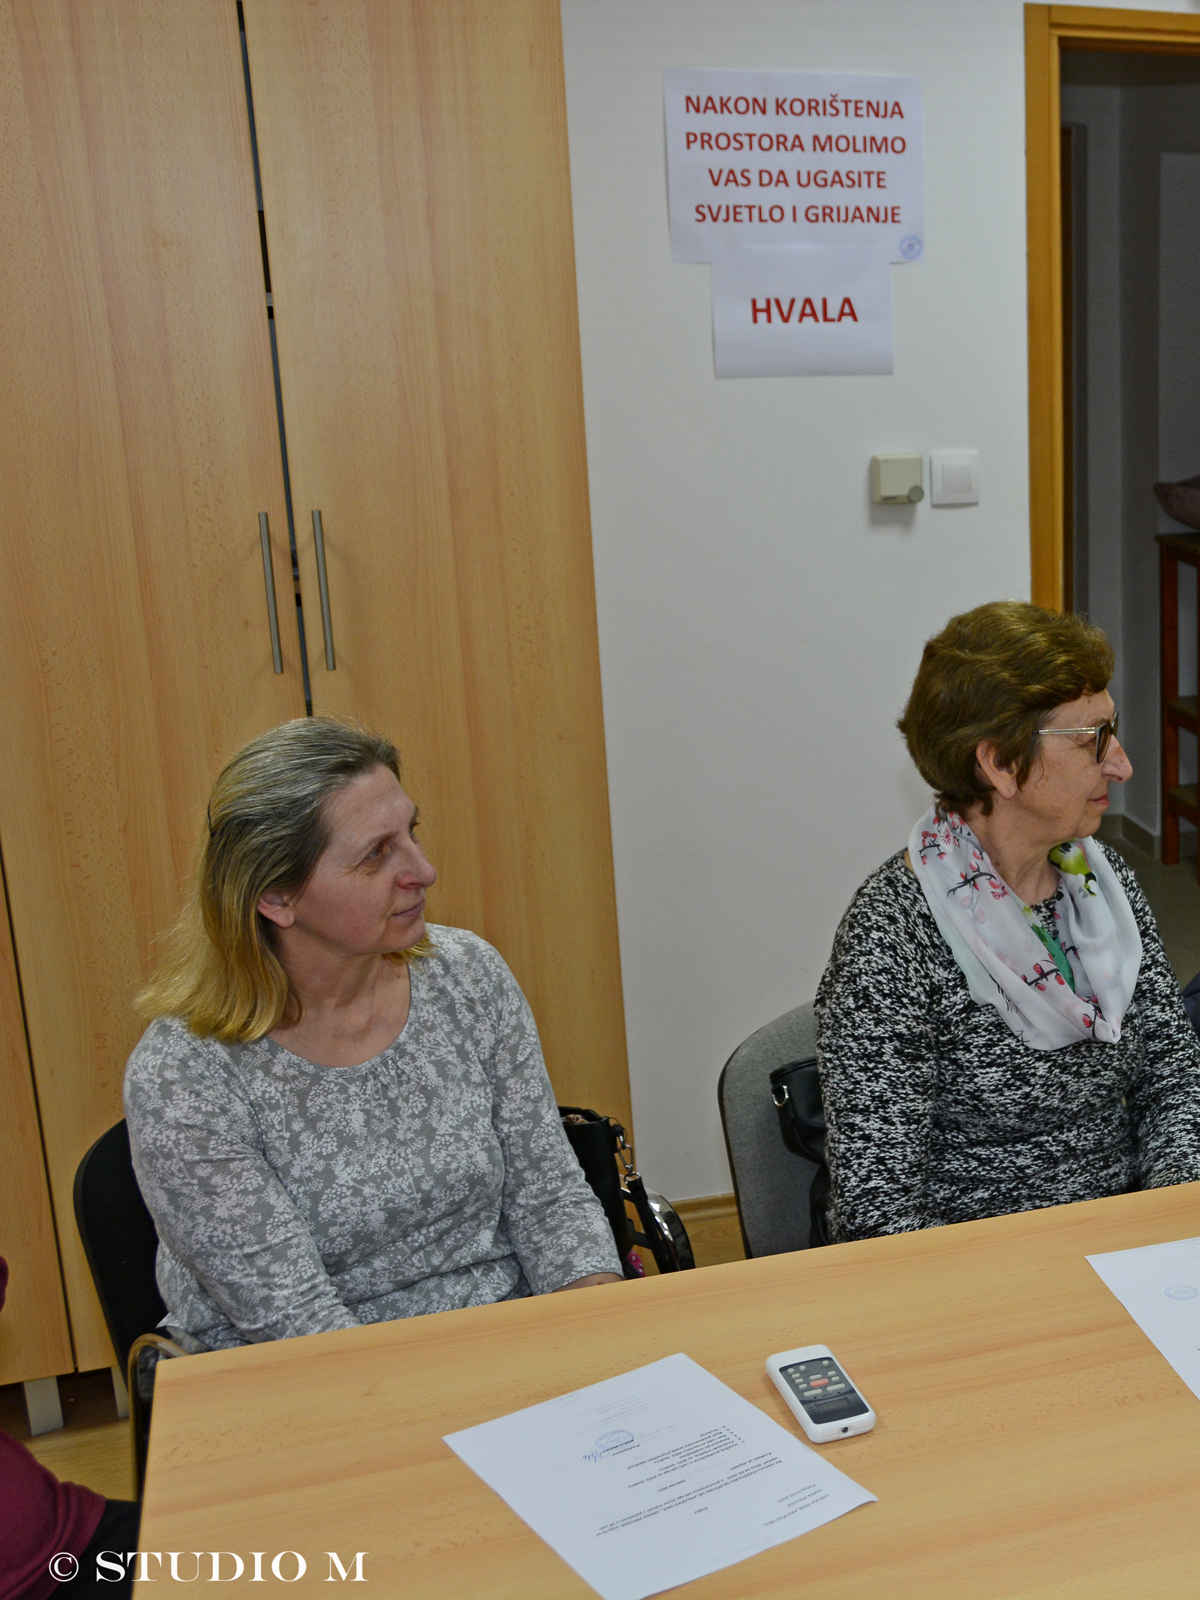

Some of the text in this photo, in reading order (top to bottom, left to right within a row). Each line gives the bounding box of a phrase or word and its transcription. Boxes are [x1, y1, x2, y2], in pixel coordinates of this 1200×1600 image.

[685, 93, 905, 119] NAKON KORIŠTENJA
[685, 131, 907, 155] PROSTORA MOLIMO
[708, 168, 886, 189] VAS DA UGASITE
[695, 204, 901, 224] SVJETLO I GRIJANJE
[751, 296, 859, 325] HVALA
